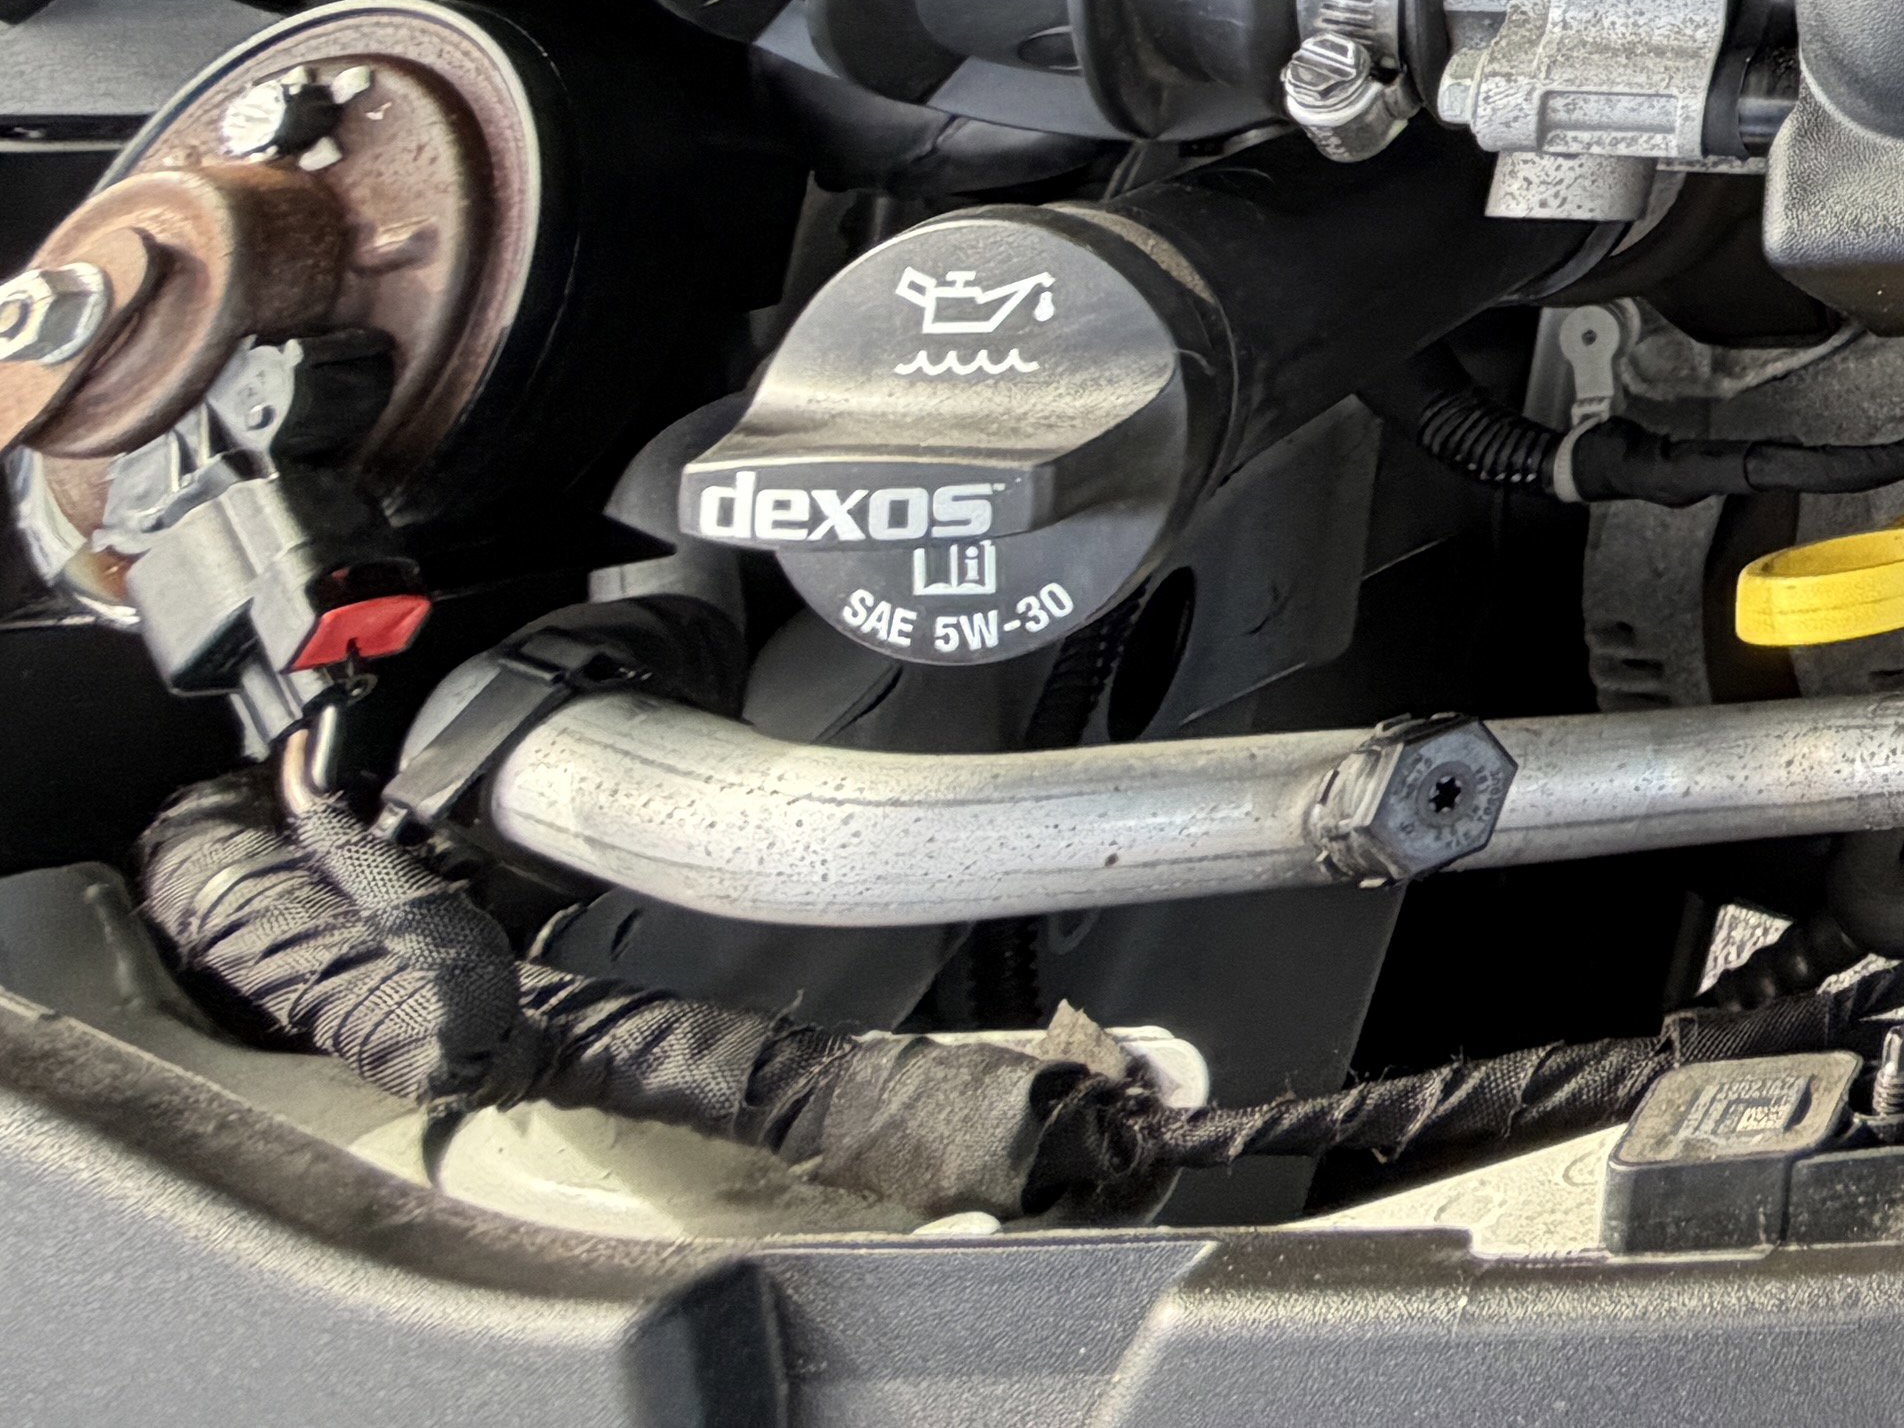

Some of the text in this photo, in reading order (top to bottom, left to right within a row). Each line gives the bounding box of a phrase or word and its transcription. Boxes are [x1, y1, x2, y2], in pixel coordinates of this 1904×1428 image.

[699, 472, 994, 542] dexos
[841, 580, 1073, 653] SAE 5W-30
